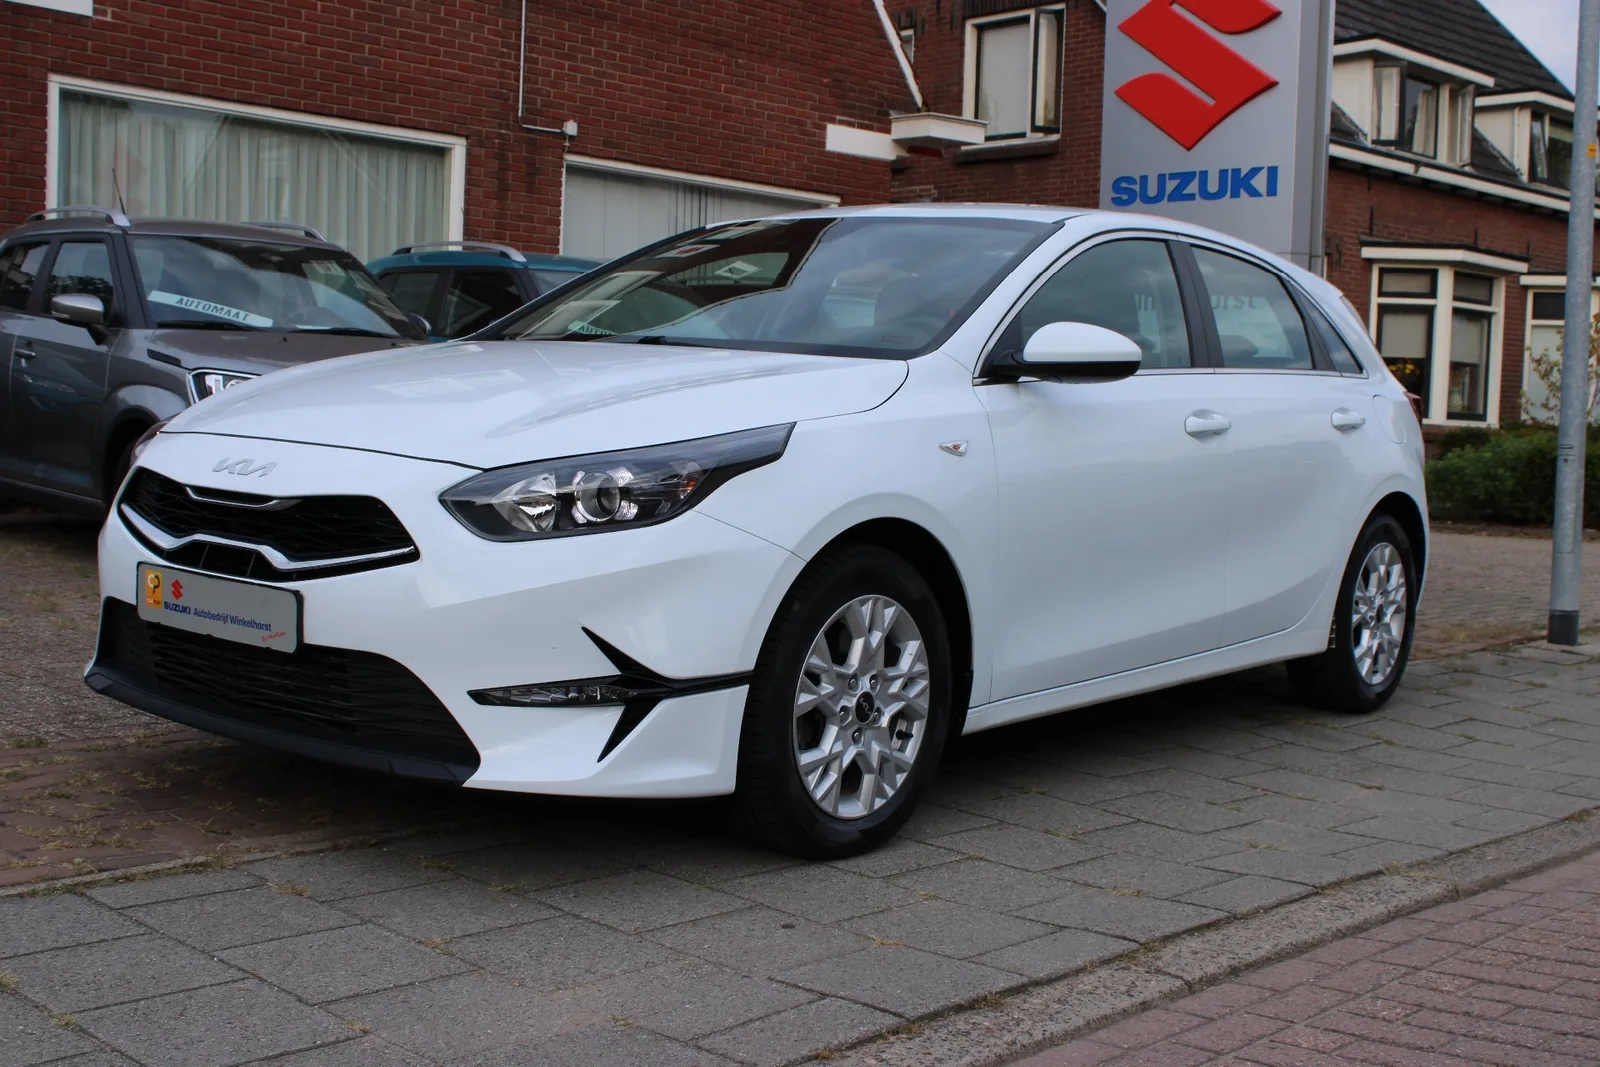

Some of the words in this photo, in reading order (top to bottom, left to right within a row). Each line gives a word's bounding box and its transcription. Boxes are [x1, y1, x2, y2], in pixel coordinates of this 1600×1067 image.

[1111, 165, 1279, 207] SUZUKI
[175, 298, 251, 321] AUTOMAAT
[212, 457, 278, 478] KIA
[164, 601, 191, 614] SUZUKI
[193, 607, 229, 624] Autobedrijf
[230, 615, 272, 632] Winkelhorst
